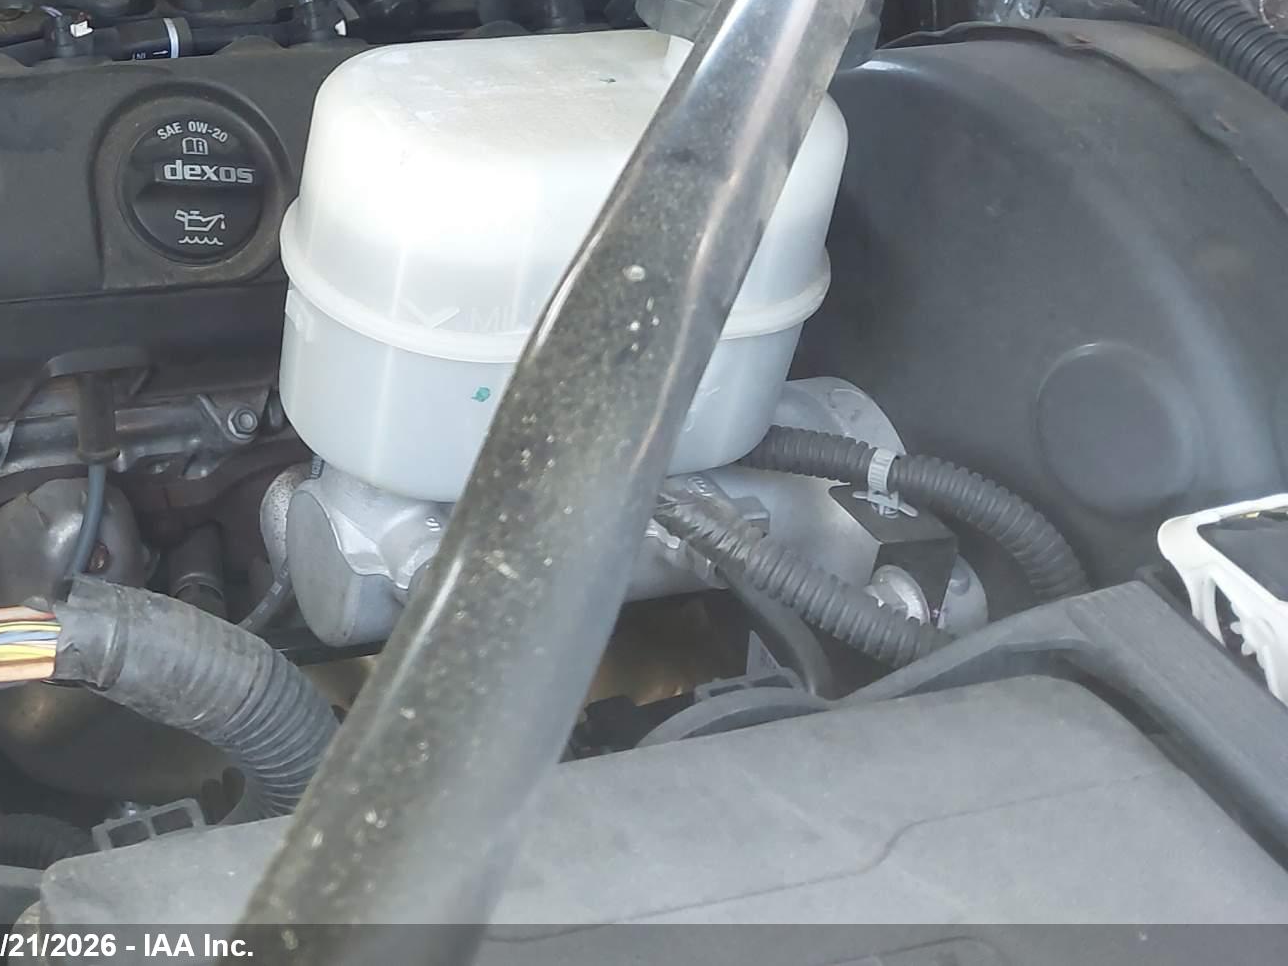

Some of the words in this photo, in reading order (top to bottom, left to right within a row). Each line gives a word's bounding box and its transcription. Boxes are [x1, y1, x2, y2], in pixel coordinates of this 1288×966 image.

[157, 121, 183, 141] SAE
[188, 120, 229, 143] 0W-20
[163, 159, 256, 184] dexos
